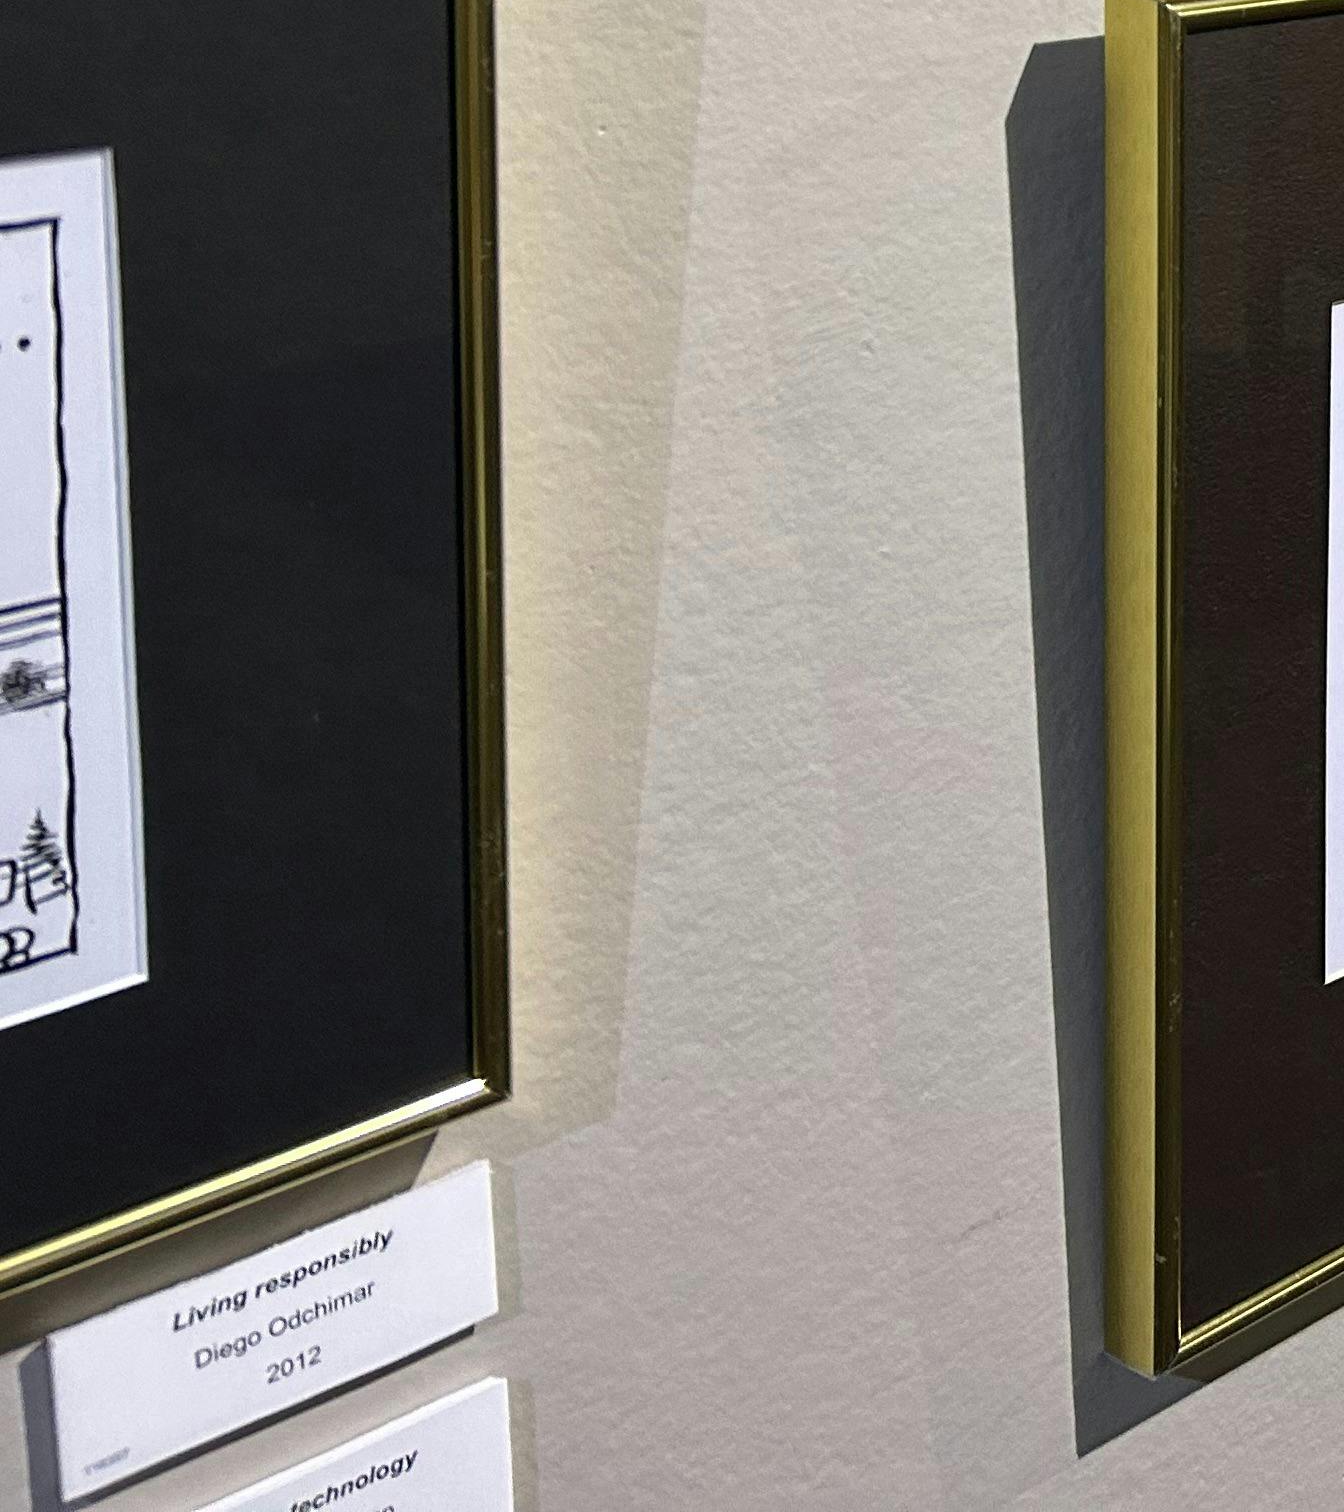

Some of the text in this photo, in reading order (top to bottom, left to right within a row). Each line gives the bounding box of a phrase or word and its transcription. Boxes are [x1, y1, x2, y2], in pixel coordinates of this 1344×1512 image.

[171, 1228, 393, 1333] Living responsibly
[194, 1281, 377, 1371] Diego Odchimar
[265, 1346, 323, 1385] 2012
